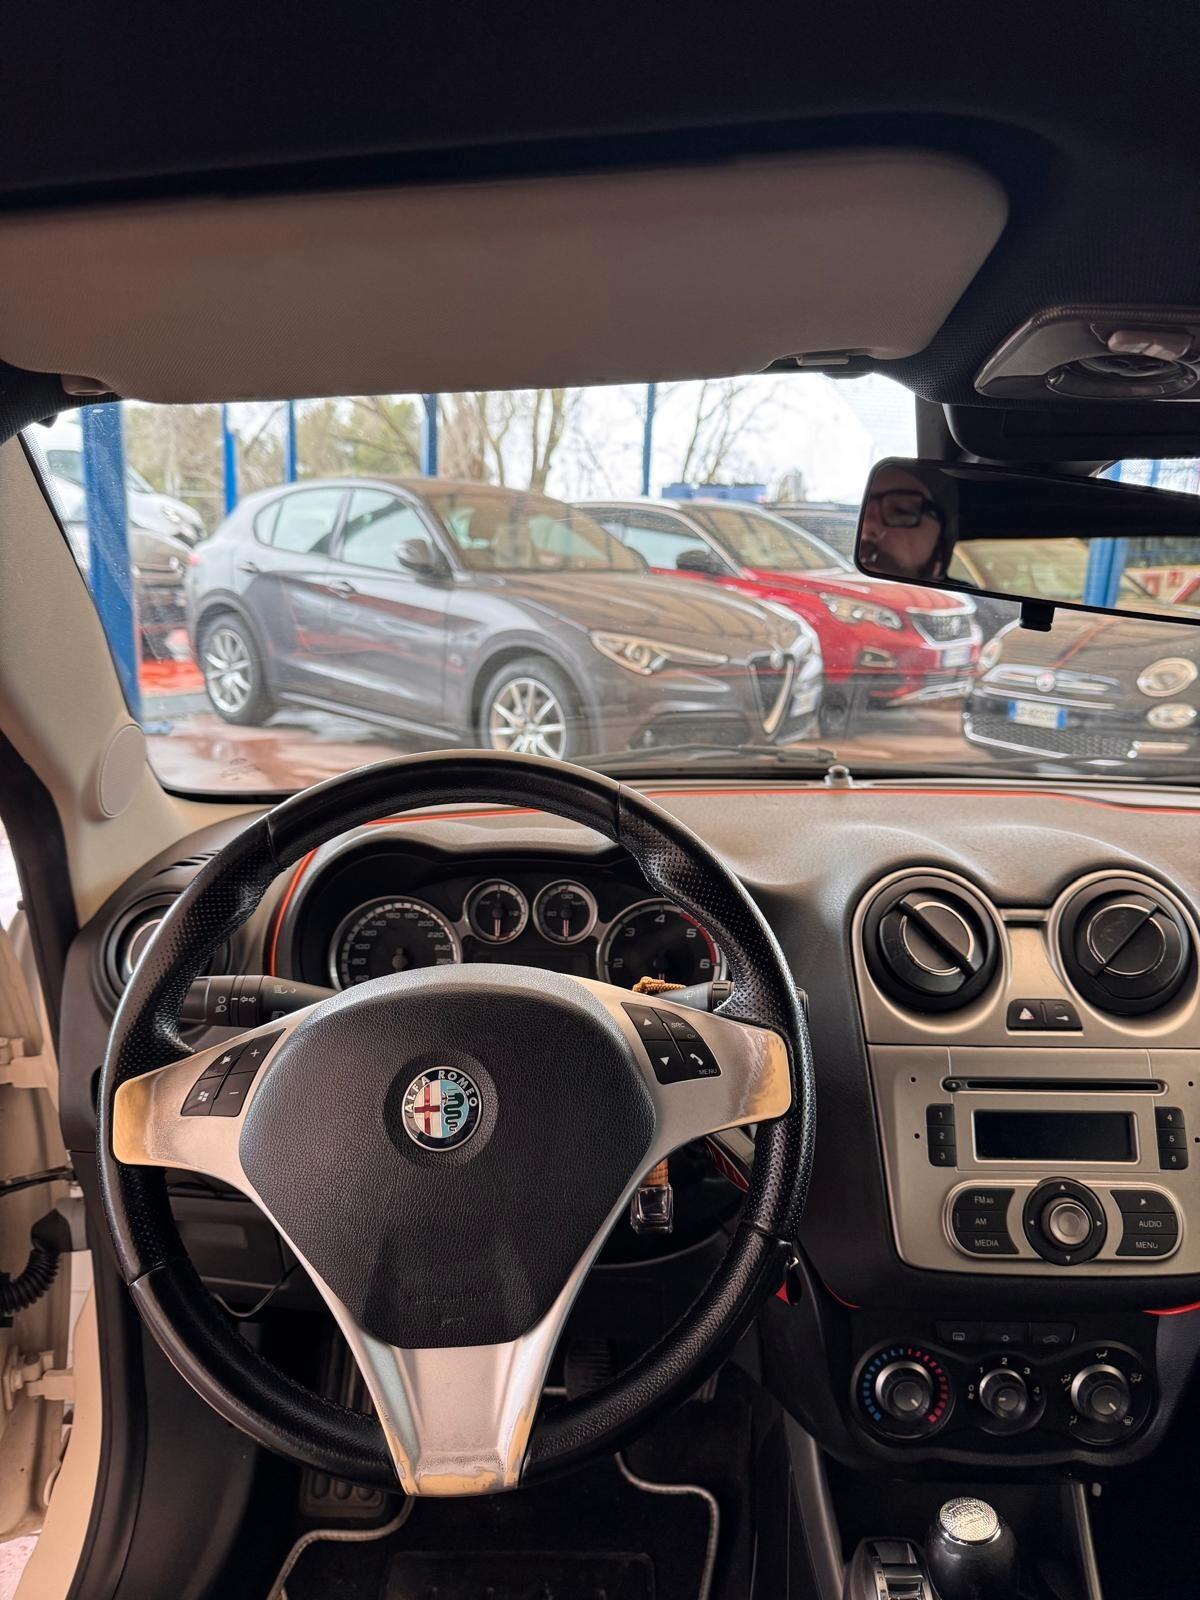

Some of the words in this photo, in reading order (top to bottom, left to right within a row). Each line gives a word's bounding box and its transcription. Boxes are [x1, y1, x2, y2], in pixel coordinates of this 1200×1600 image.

[654, 914, 666, 923] 4
[624, 927, 636, 937] 3
[685, 928, 697, 938] 5
[612, 958, 624, 968] 2
[699, 958, 711, 969] 6
[404, 1075, 431, 1113] ALFA
[437, 1070, 478, 1107] ROMEO
[938, 1111, 944, 1119] 1
[1166, 1113, 1173, 1122] 4
[938, 1132, 945, 1140] 2
[1168, 1135, 1175, 1143] 5
[939, 1152, 946, 1160] 3
[1170, 1155, 1177, 1163] 6
[974, 1218, 987, 1226] AM
[1138, 1220, 1163, 1229] AUDIO
[974, 1239, 999, 1248] MEDIA
[1135, 1241, 1159, 1250] MENU
[1001, 1357, 1008, 1365] 2
[979, 1366, 984, 1375] 1
[1024, 1366, 1031, 1375] 3
[1033, 1385, 1040, 1395] 4
